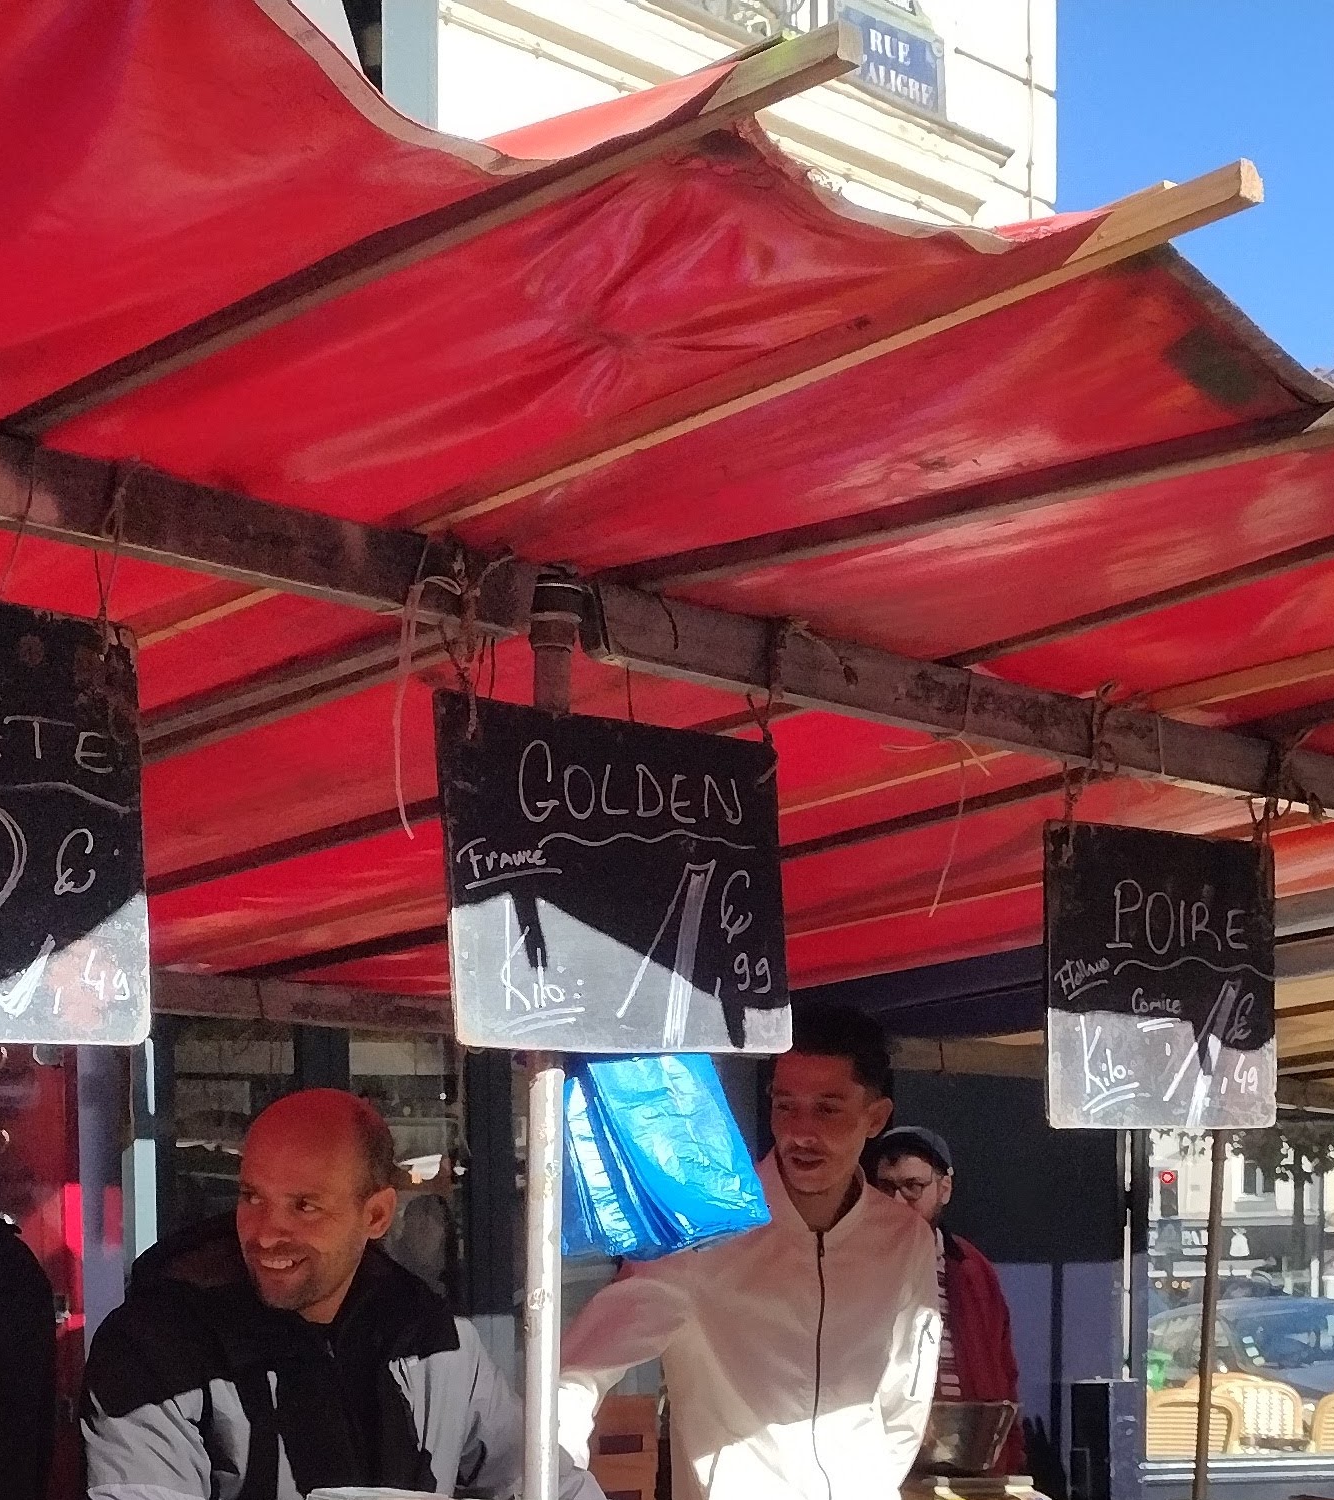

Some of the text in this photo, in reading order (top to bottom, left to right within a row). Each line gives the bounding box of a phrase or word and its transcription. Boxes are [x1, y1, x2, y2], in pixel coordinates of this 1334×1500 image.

[869, 28, 910, 66] RUE
[856, 54, 934, 109] 'ALIGRE
[519, 740, 743, 824] GOLDEN
[1105, 879, 1249, 955] POIRE
